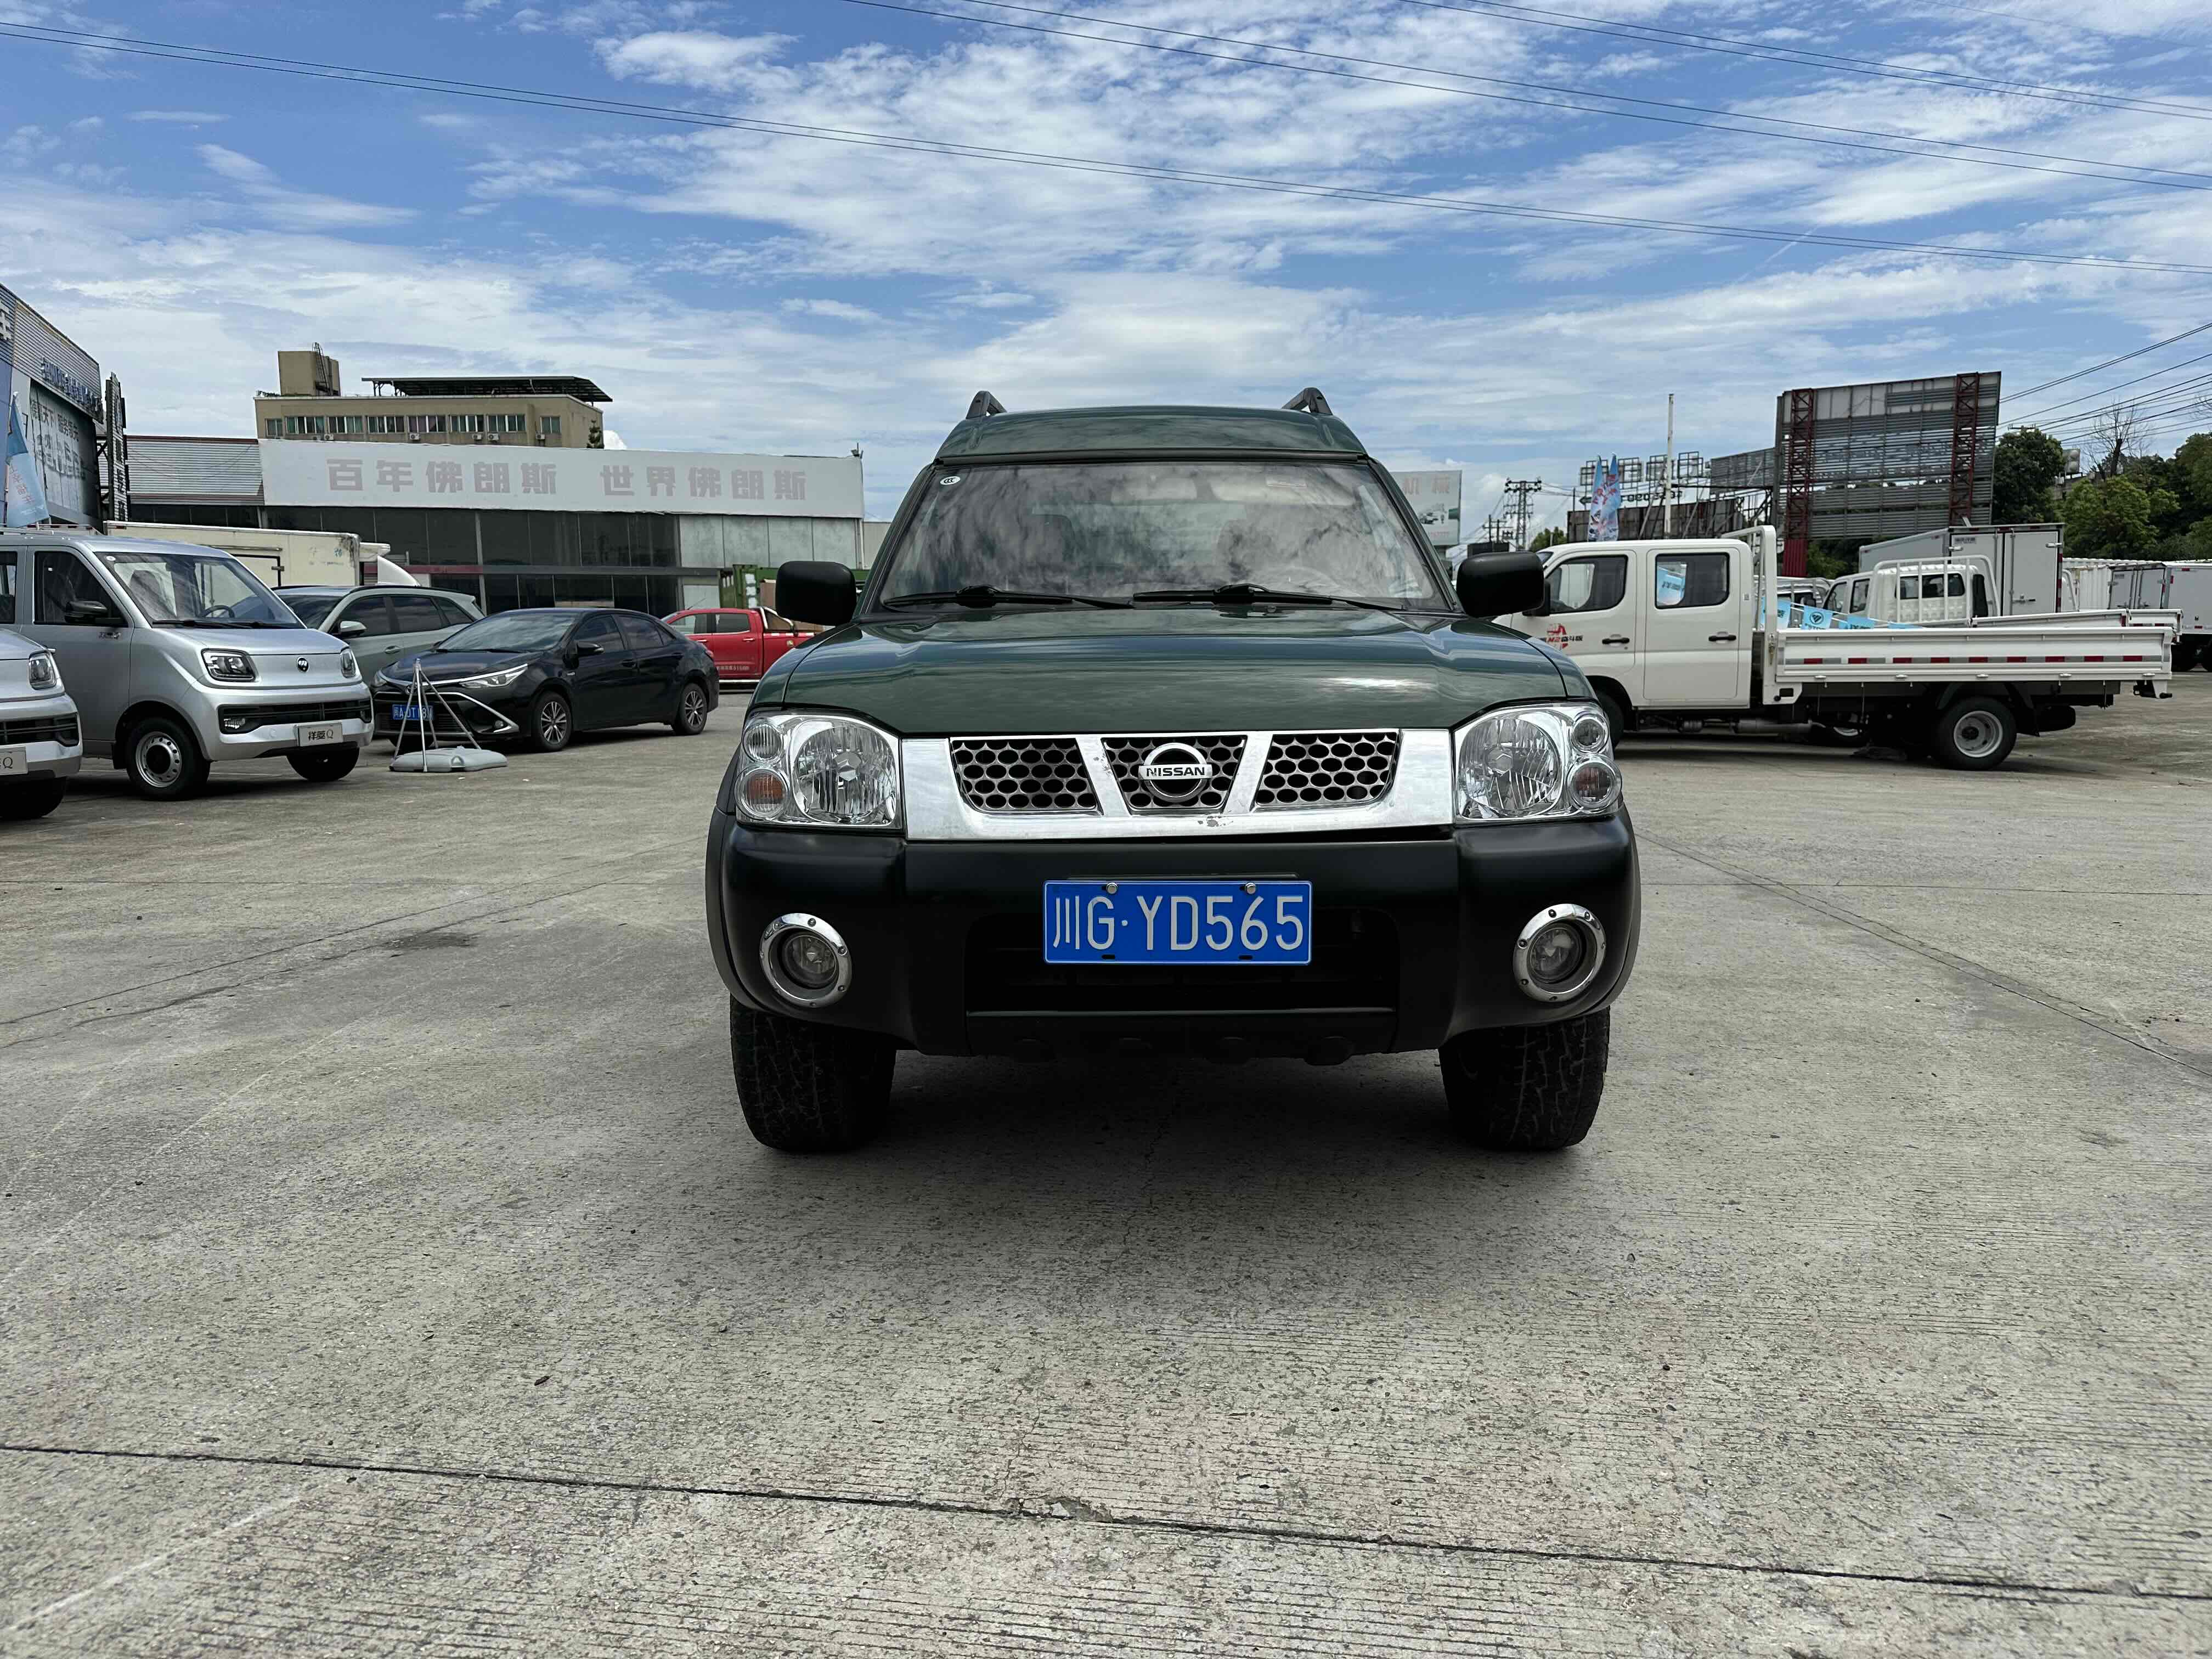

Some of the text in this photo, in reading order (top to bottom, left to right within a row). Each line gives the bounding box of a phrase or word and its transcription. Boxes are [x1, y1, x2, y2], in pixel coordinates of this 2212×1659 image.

[327, 459, 557, 494] 百年佛朗斯
[600, 465, 808, 500] 世界佛朗斯
[1146, 766, 1206, 777] NISSAN
[1053, 895, 1304, 951] 川G·YD565
